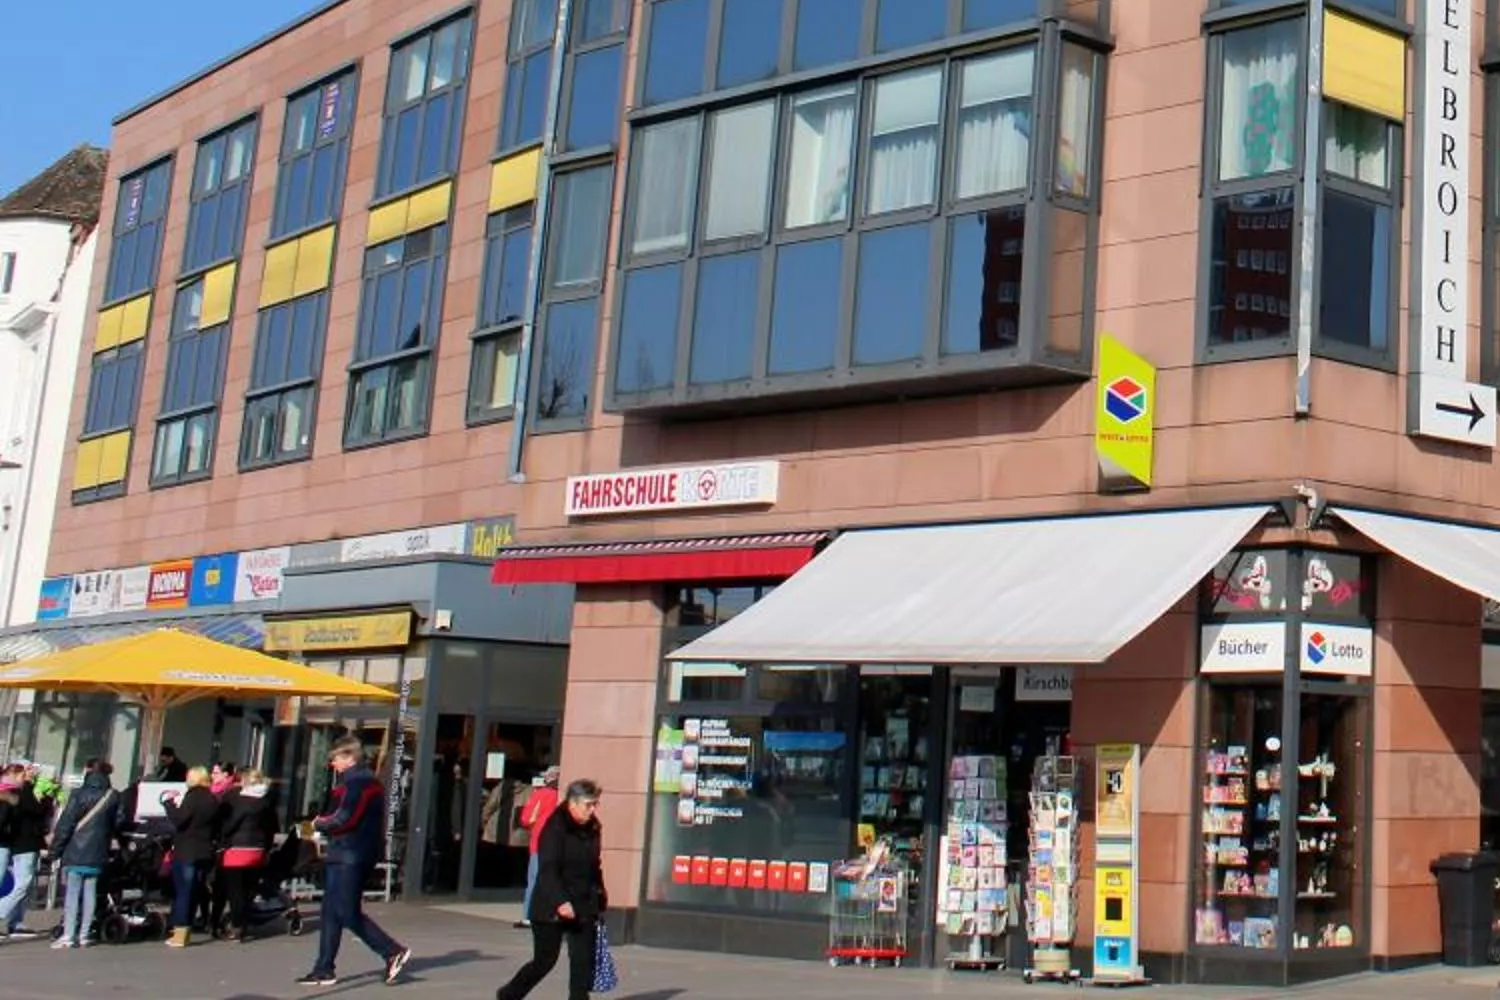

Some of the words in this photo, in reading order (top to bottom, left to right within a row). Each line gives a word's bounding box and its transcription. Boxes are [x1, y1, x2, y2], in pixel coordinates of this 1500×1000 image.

[572, 473, 678, 509] FAHRSCHULE
[153, 570, 186, 592] NORMA
[1218, 638, 1268, 656] Bücher
[1331, 641, 1363, 659] Lotto
